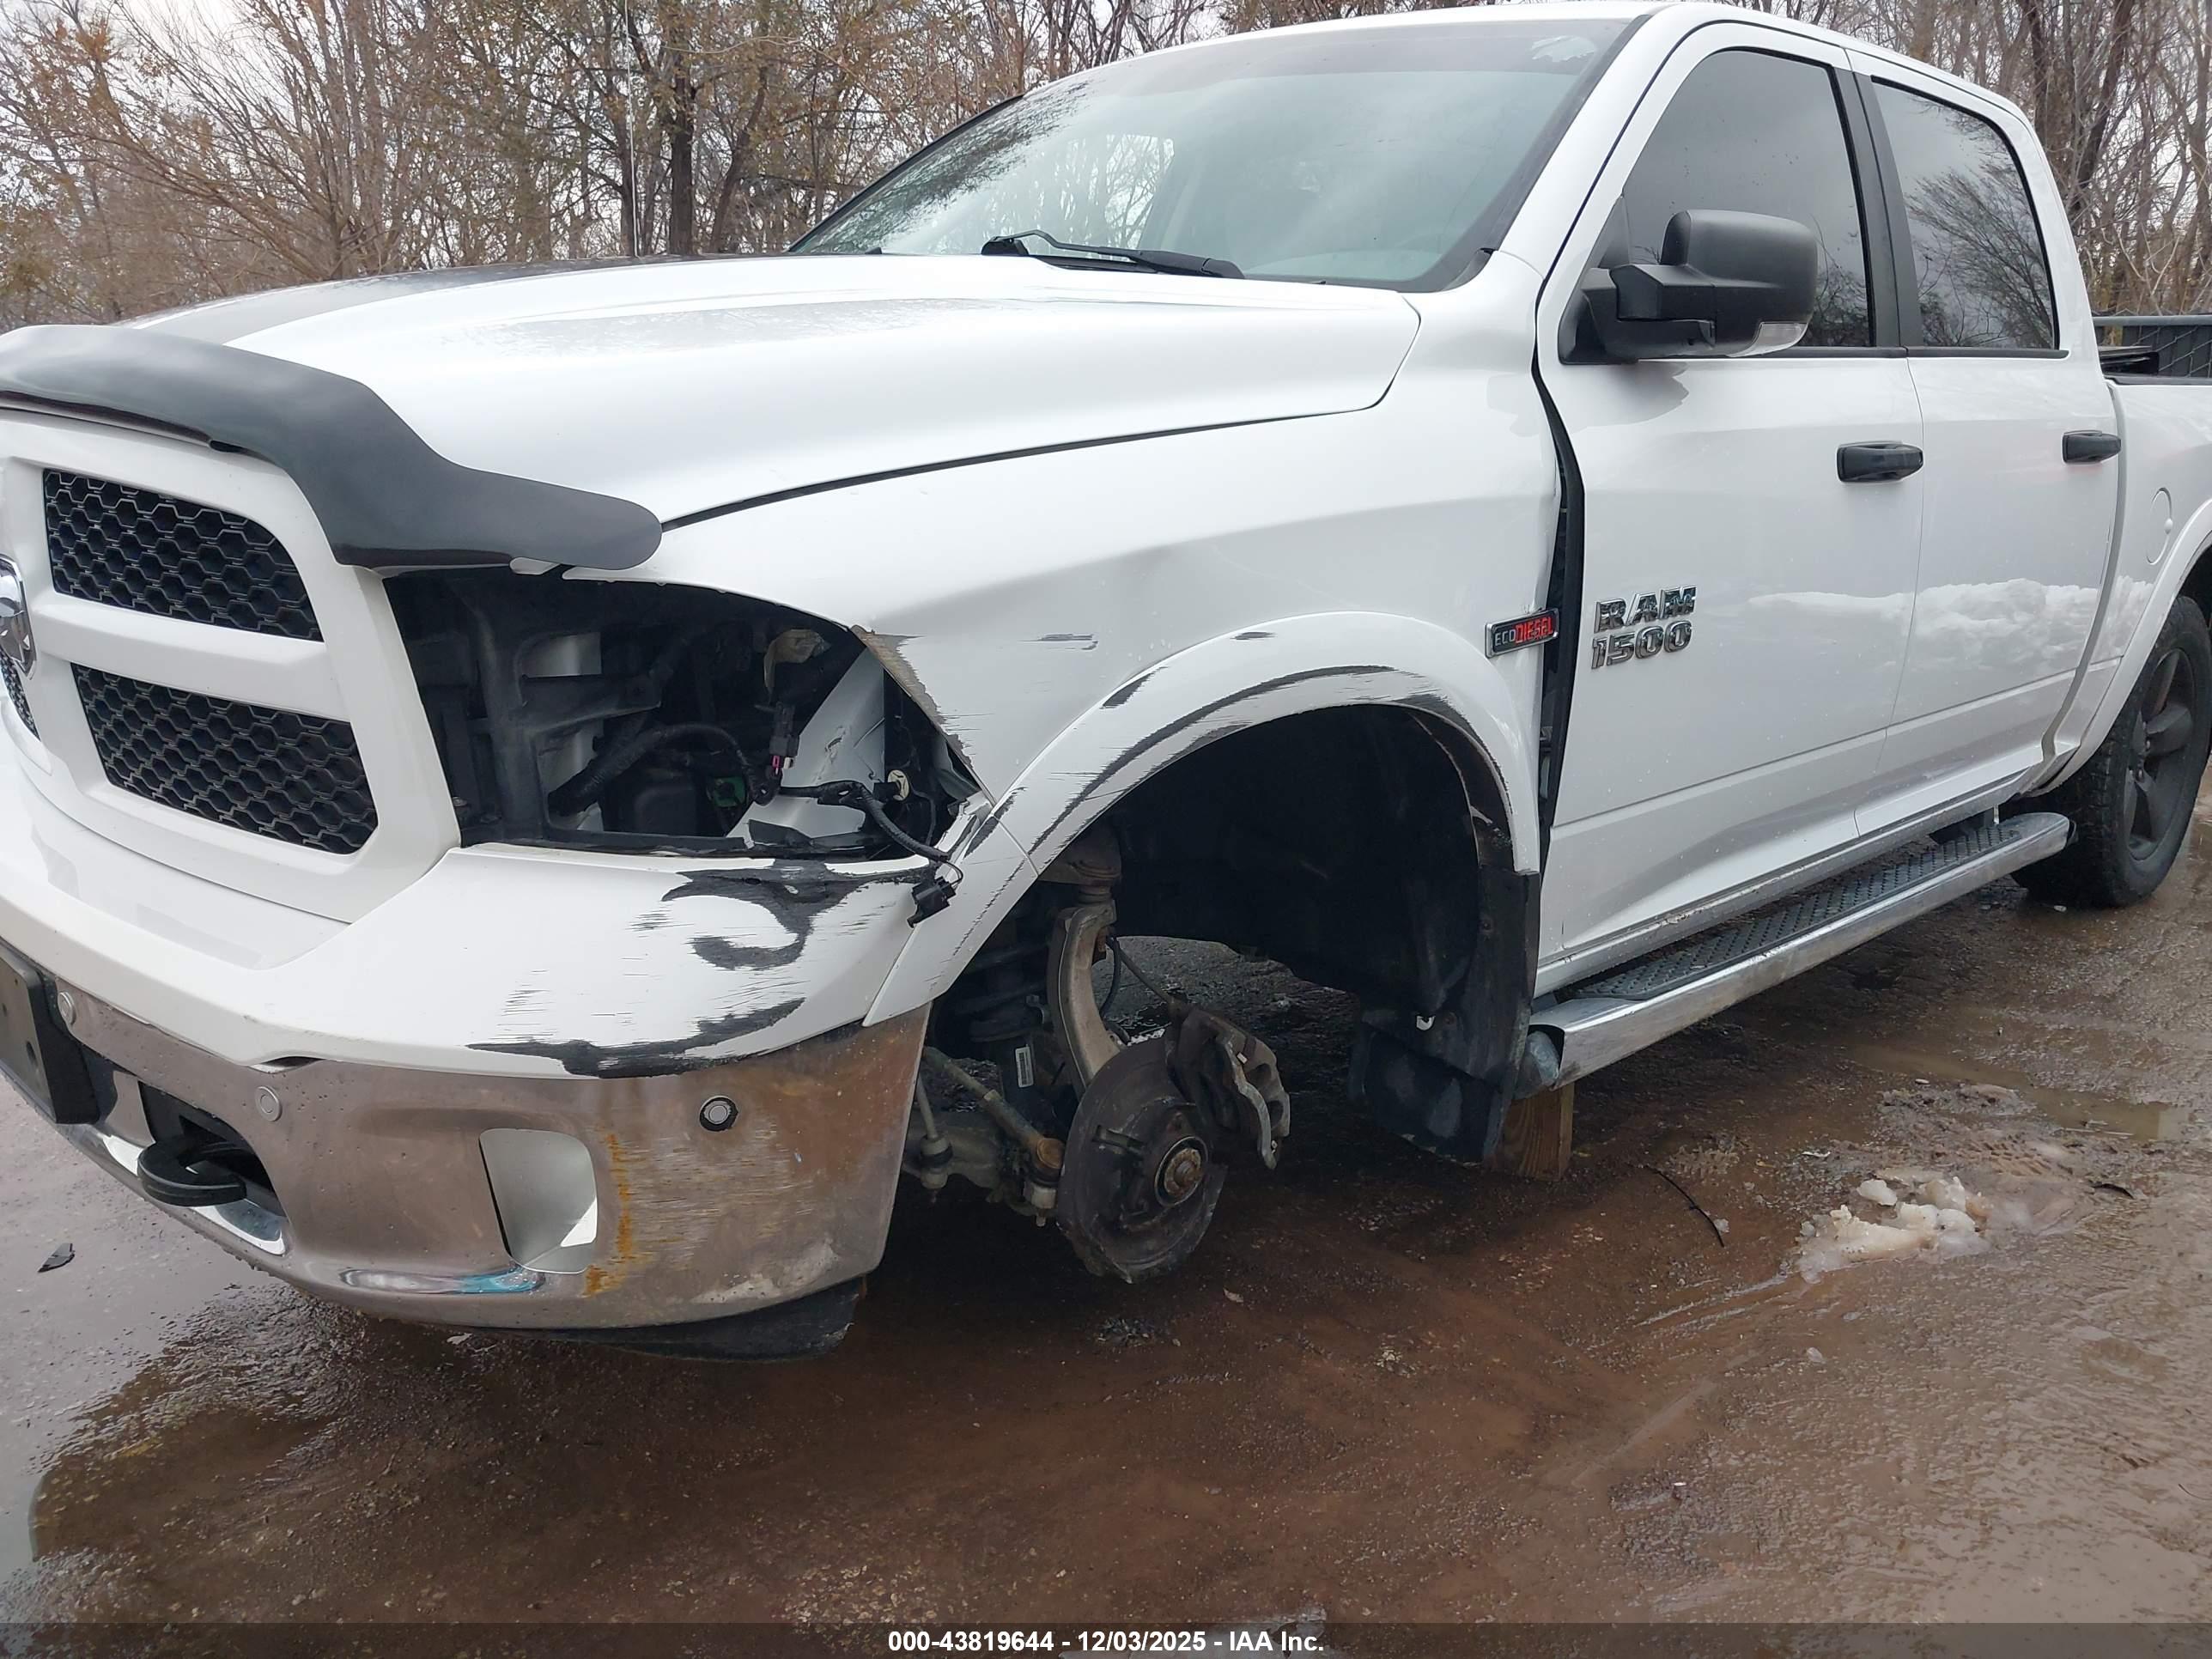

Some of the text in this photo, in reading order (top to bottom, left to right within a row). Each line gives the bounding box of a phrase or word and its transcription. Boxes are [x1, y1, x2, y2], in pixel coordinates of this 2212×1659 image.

[1495, 616, 1553, 647] ECODIESEL
[1595, 586, 1697, 633] RAM
[1591, 621, 1692, 670] 1500
